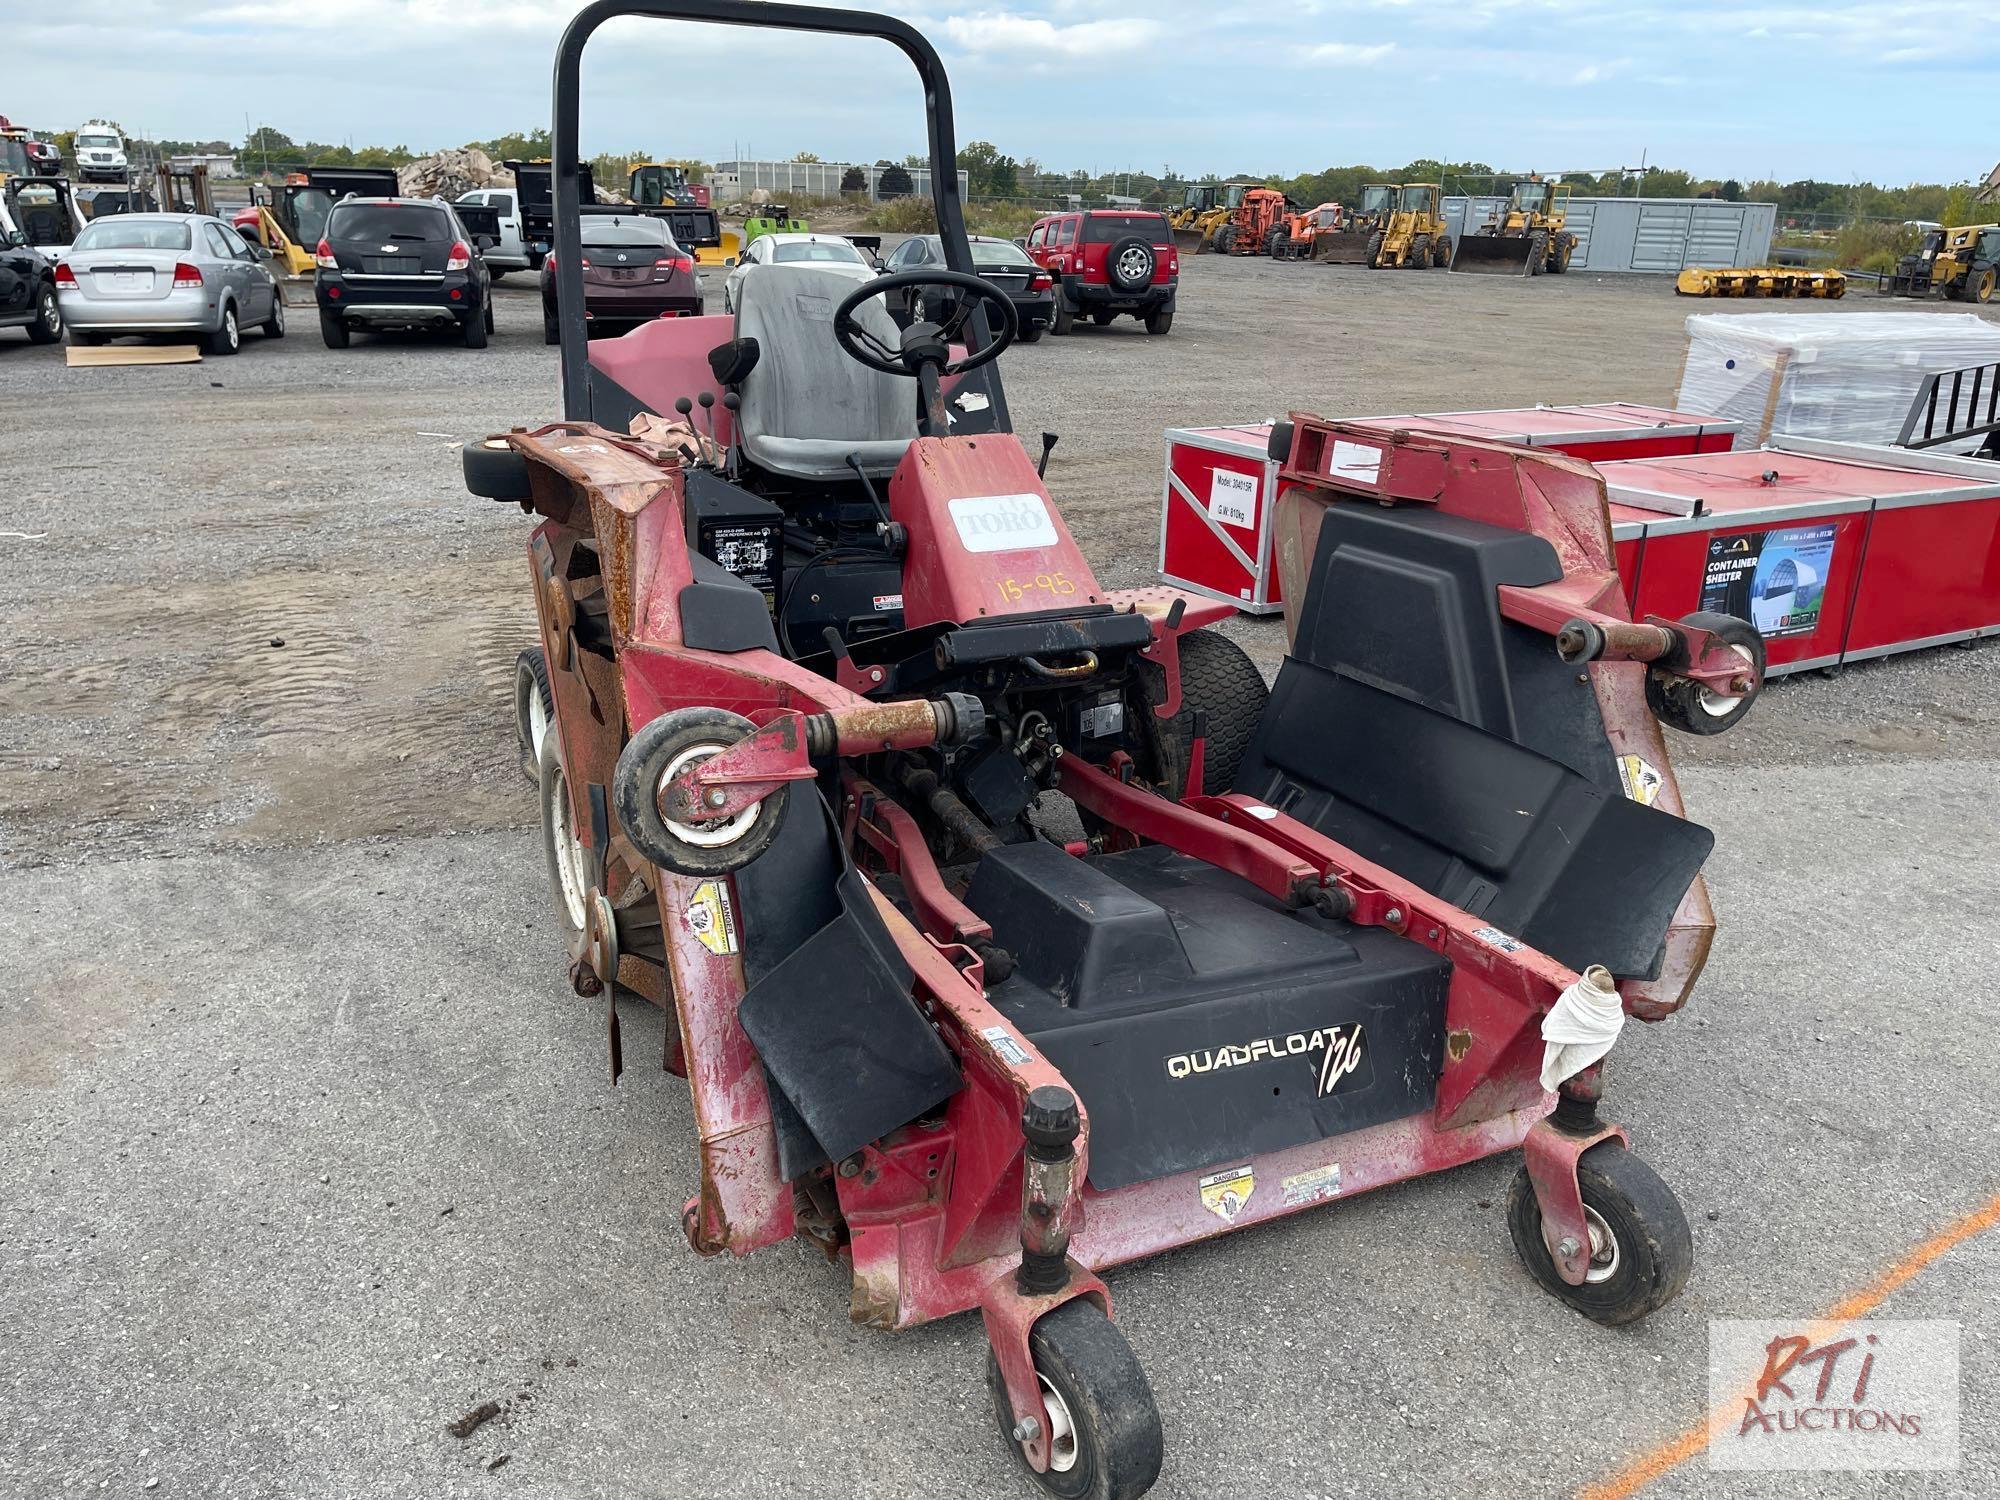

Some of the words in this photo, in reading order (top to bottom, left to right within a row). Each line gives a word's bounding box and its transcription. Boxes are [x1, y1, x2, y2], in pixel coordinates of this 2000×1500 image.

[959, 509, 1043, 535] TORO
[1705, 571, 1742, 585] SHELTER
[1707, 557, 1758, 573] CONTAINER
[995, 572, 1075, 603] 15-95
[722, 900, 733, 935] DANGER
[1167, 1026, 1341, 1079] QUADFLOAT
[1318, 1024, 1362, 1098] 126
[1213, 1171, 1239, 1184] DANGER
